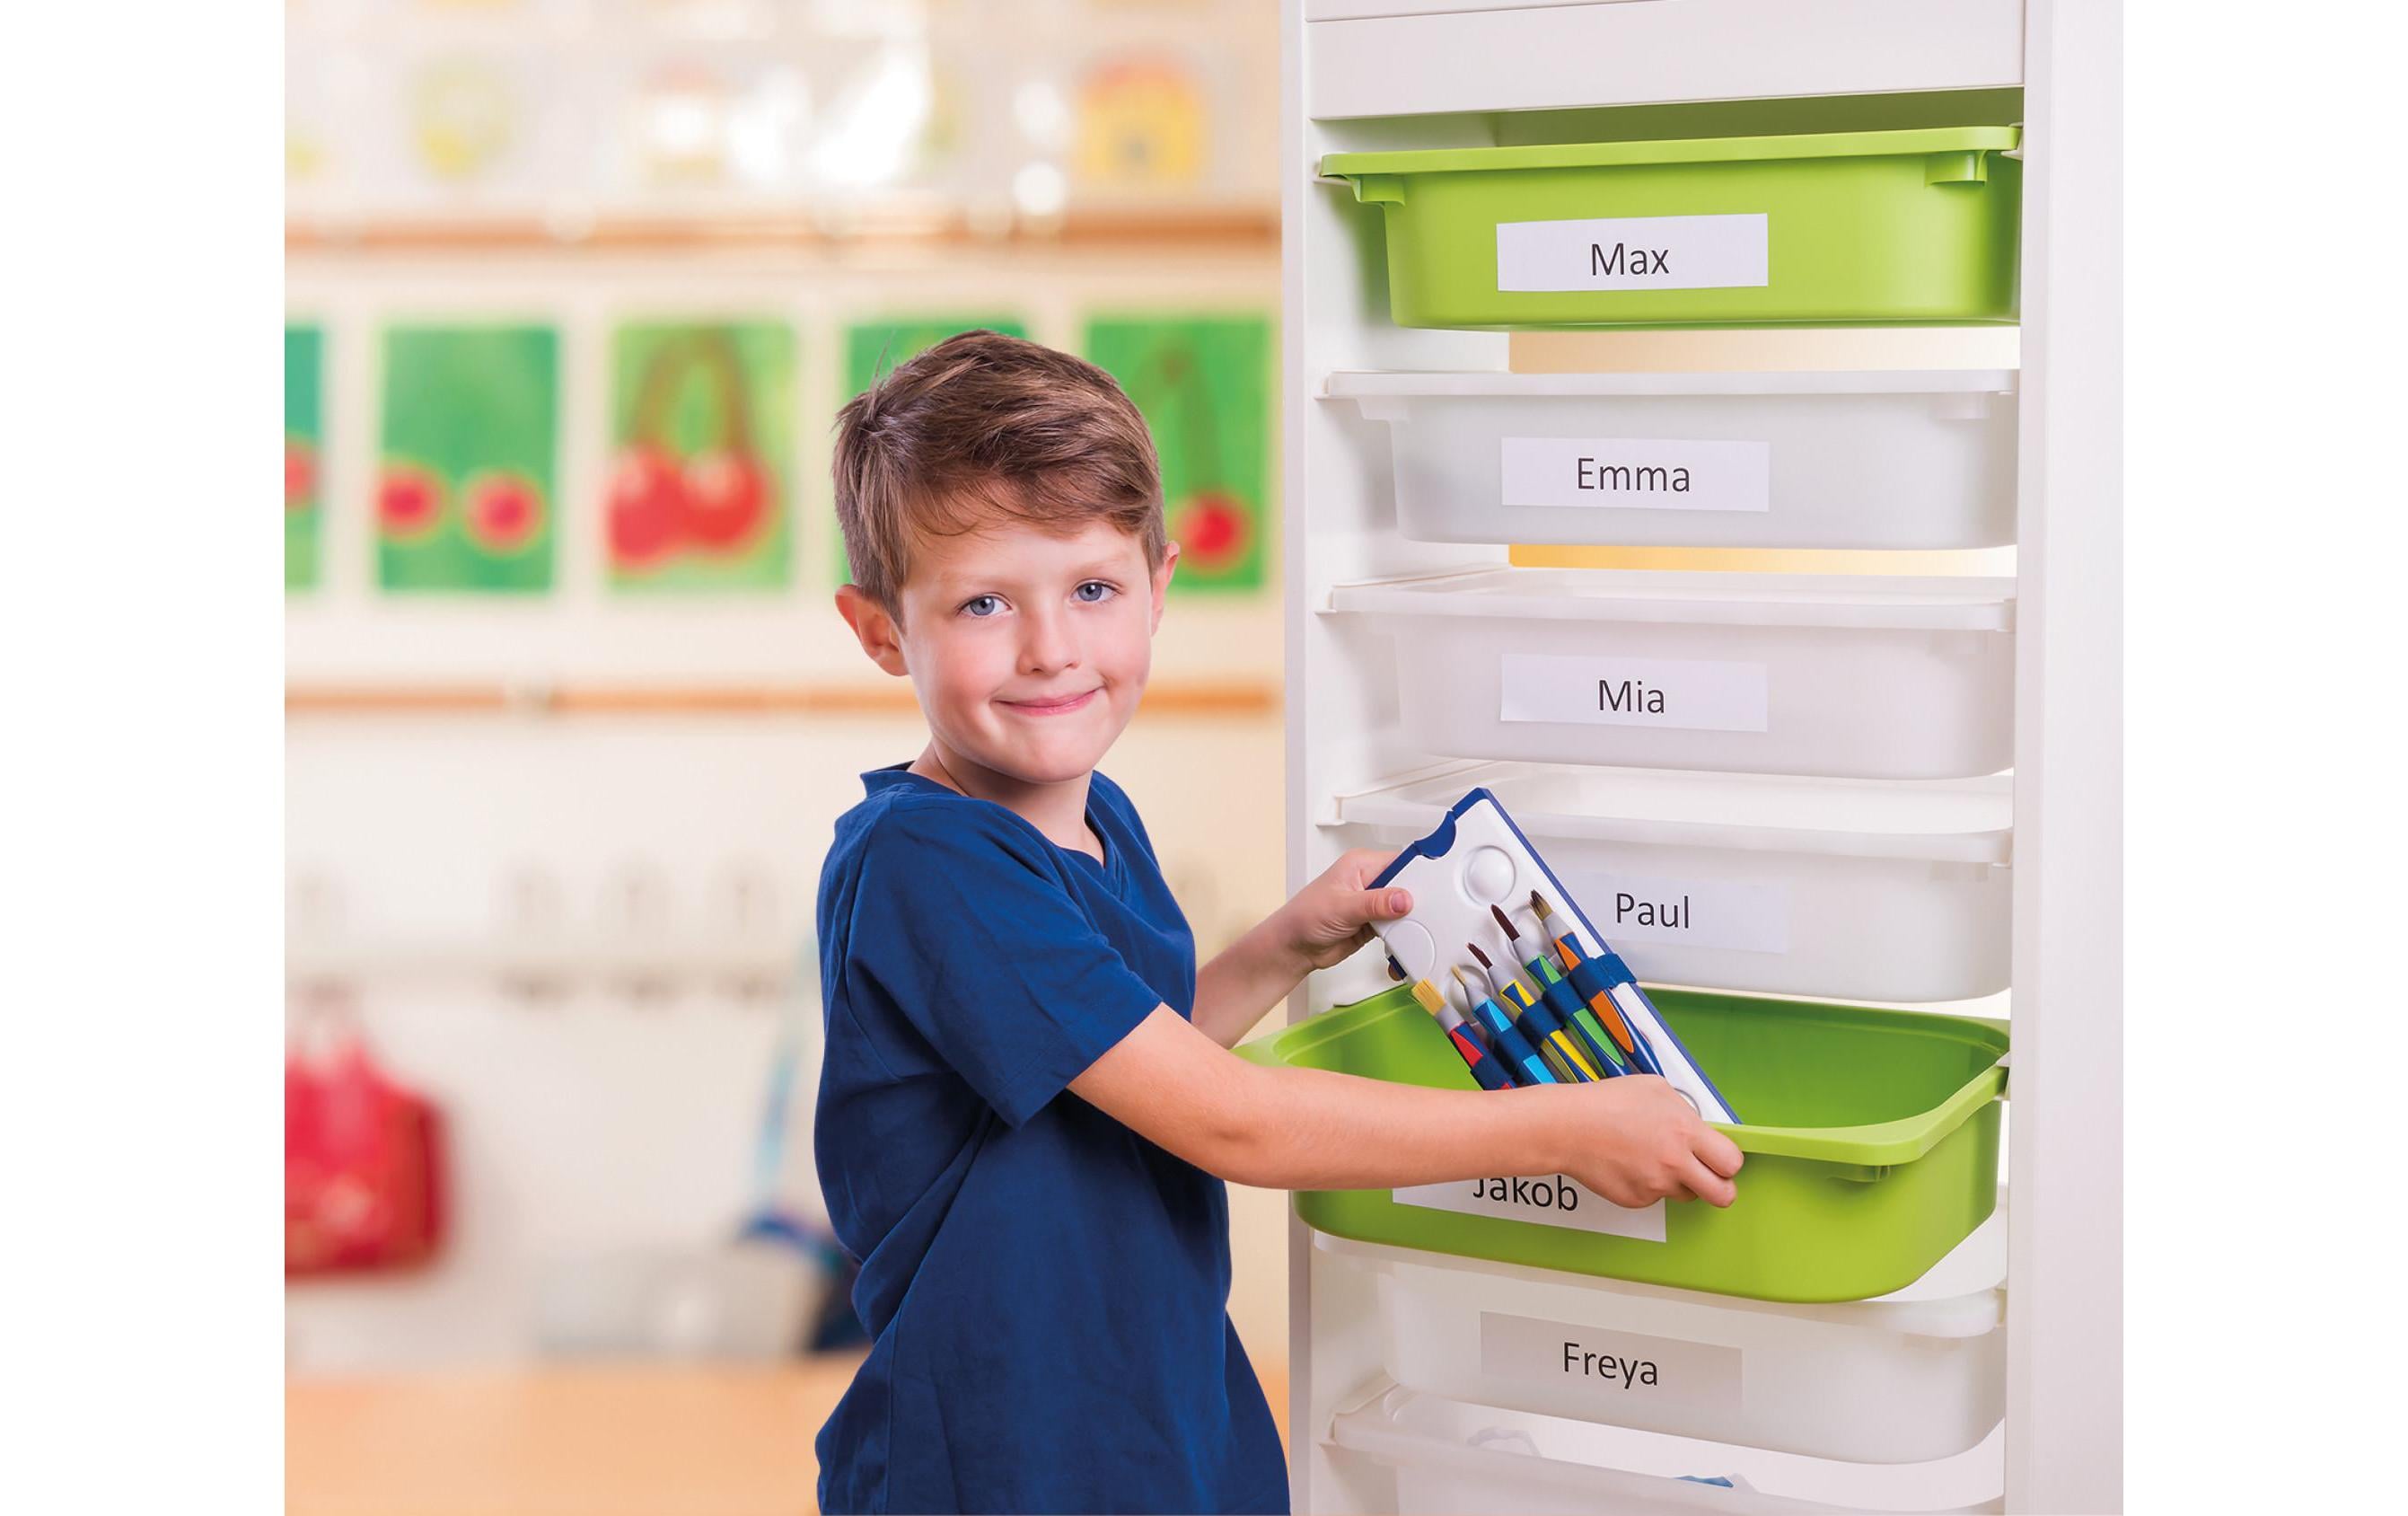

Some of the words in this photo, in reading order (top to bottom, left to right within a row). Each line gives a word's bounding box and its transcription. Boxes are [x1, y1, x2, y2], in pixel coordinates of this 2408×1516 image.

[1591, 242, 1670, 277] Max
[1578, 457, 1690, 492] Emma
[1599, 679, 1665, 714] Mia
[1616, 893, 1689, 930] Paul
[1472, 1175, 1578, 1212] Jakob
[1563, 1341, 1658, 1390] Freya
